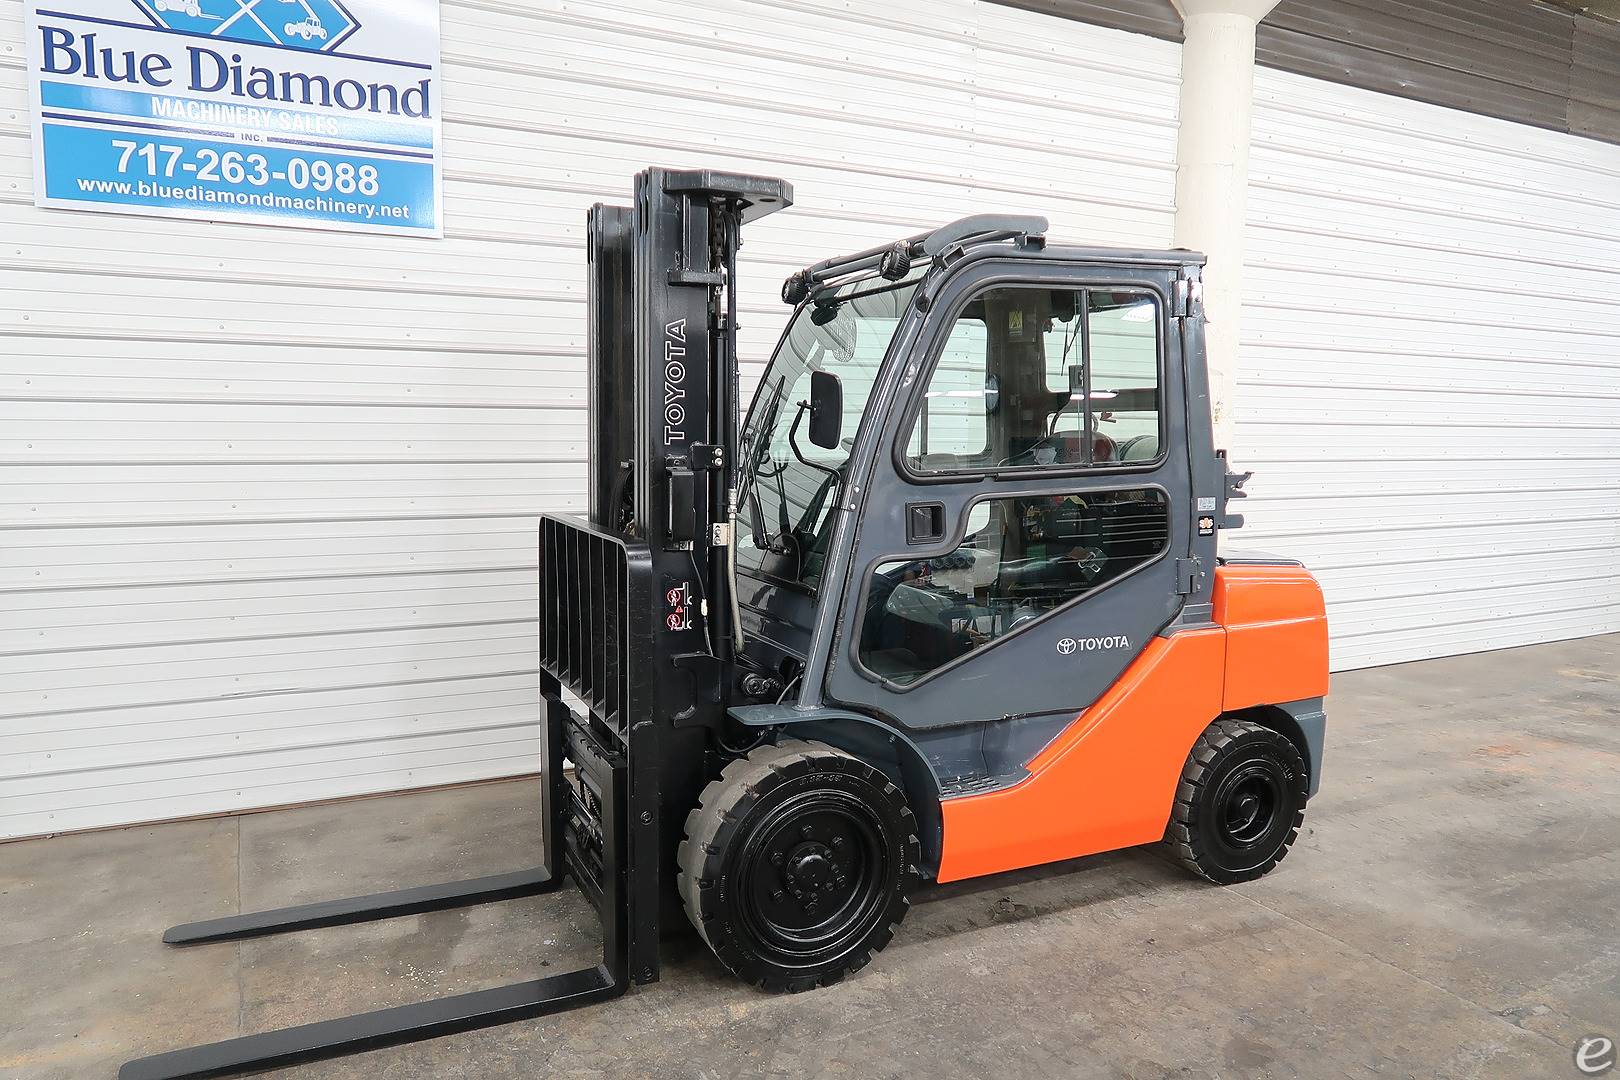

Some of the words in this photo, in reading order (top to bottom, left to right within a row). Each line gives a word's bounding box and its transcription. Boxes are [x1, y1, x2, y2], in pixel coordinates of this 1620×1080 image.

[37, 25, 173, 87] Blue
[185, 45, 432, 119] Diamond
[151, 96, 273, 130] MACHINERY
[279, 109, 339, 136] SALES
[240, 133, 264, 143] INC.
[111, 139, 380, 196] 717-263-0988
[77, 178, 410, 219] www.bluediamondmachinery.net
[664, 318, 687, 446] TOYOTA
[1078, 635, 1130, 651] TOYOTA
